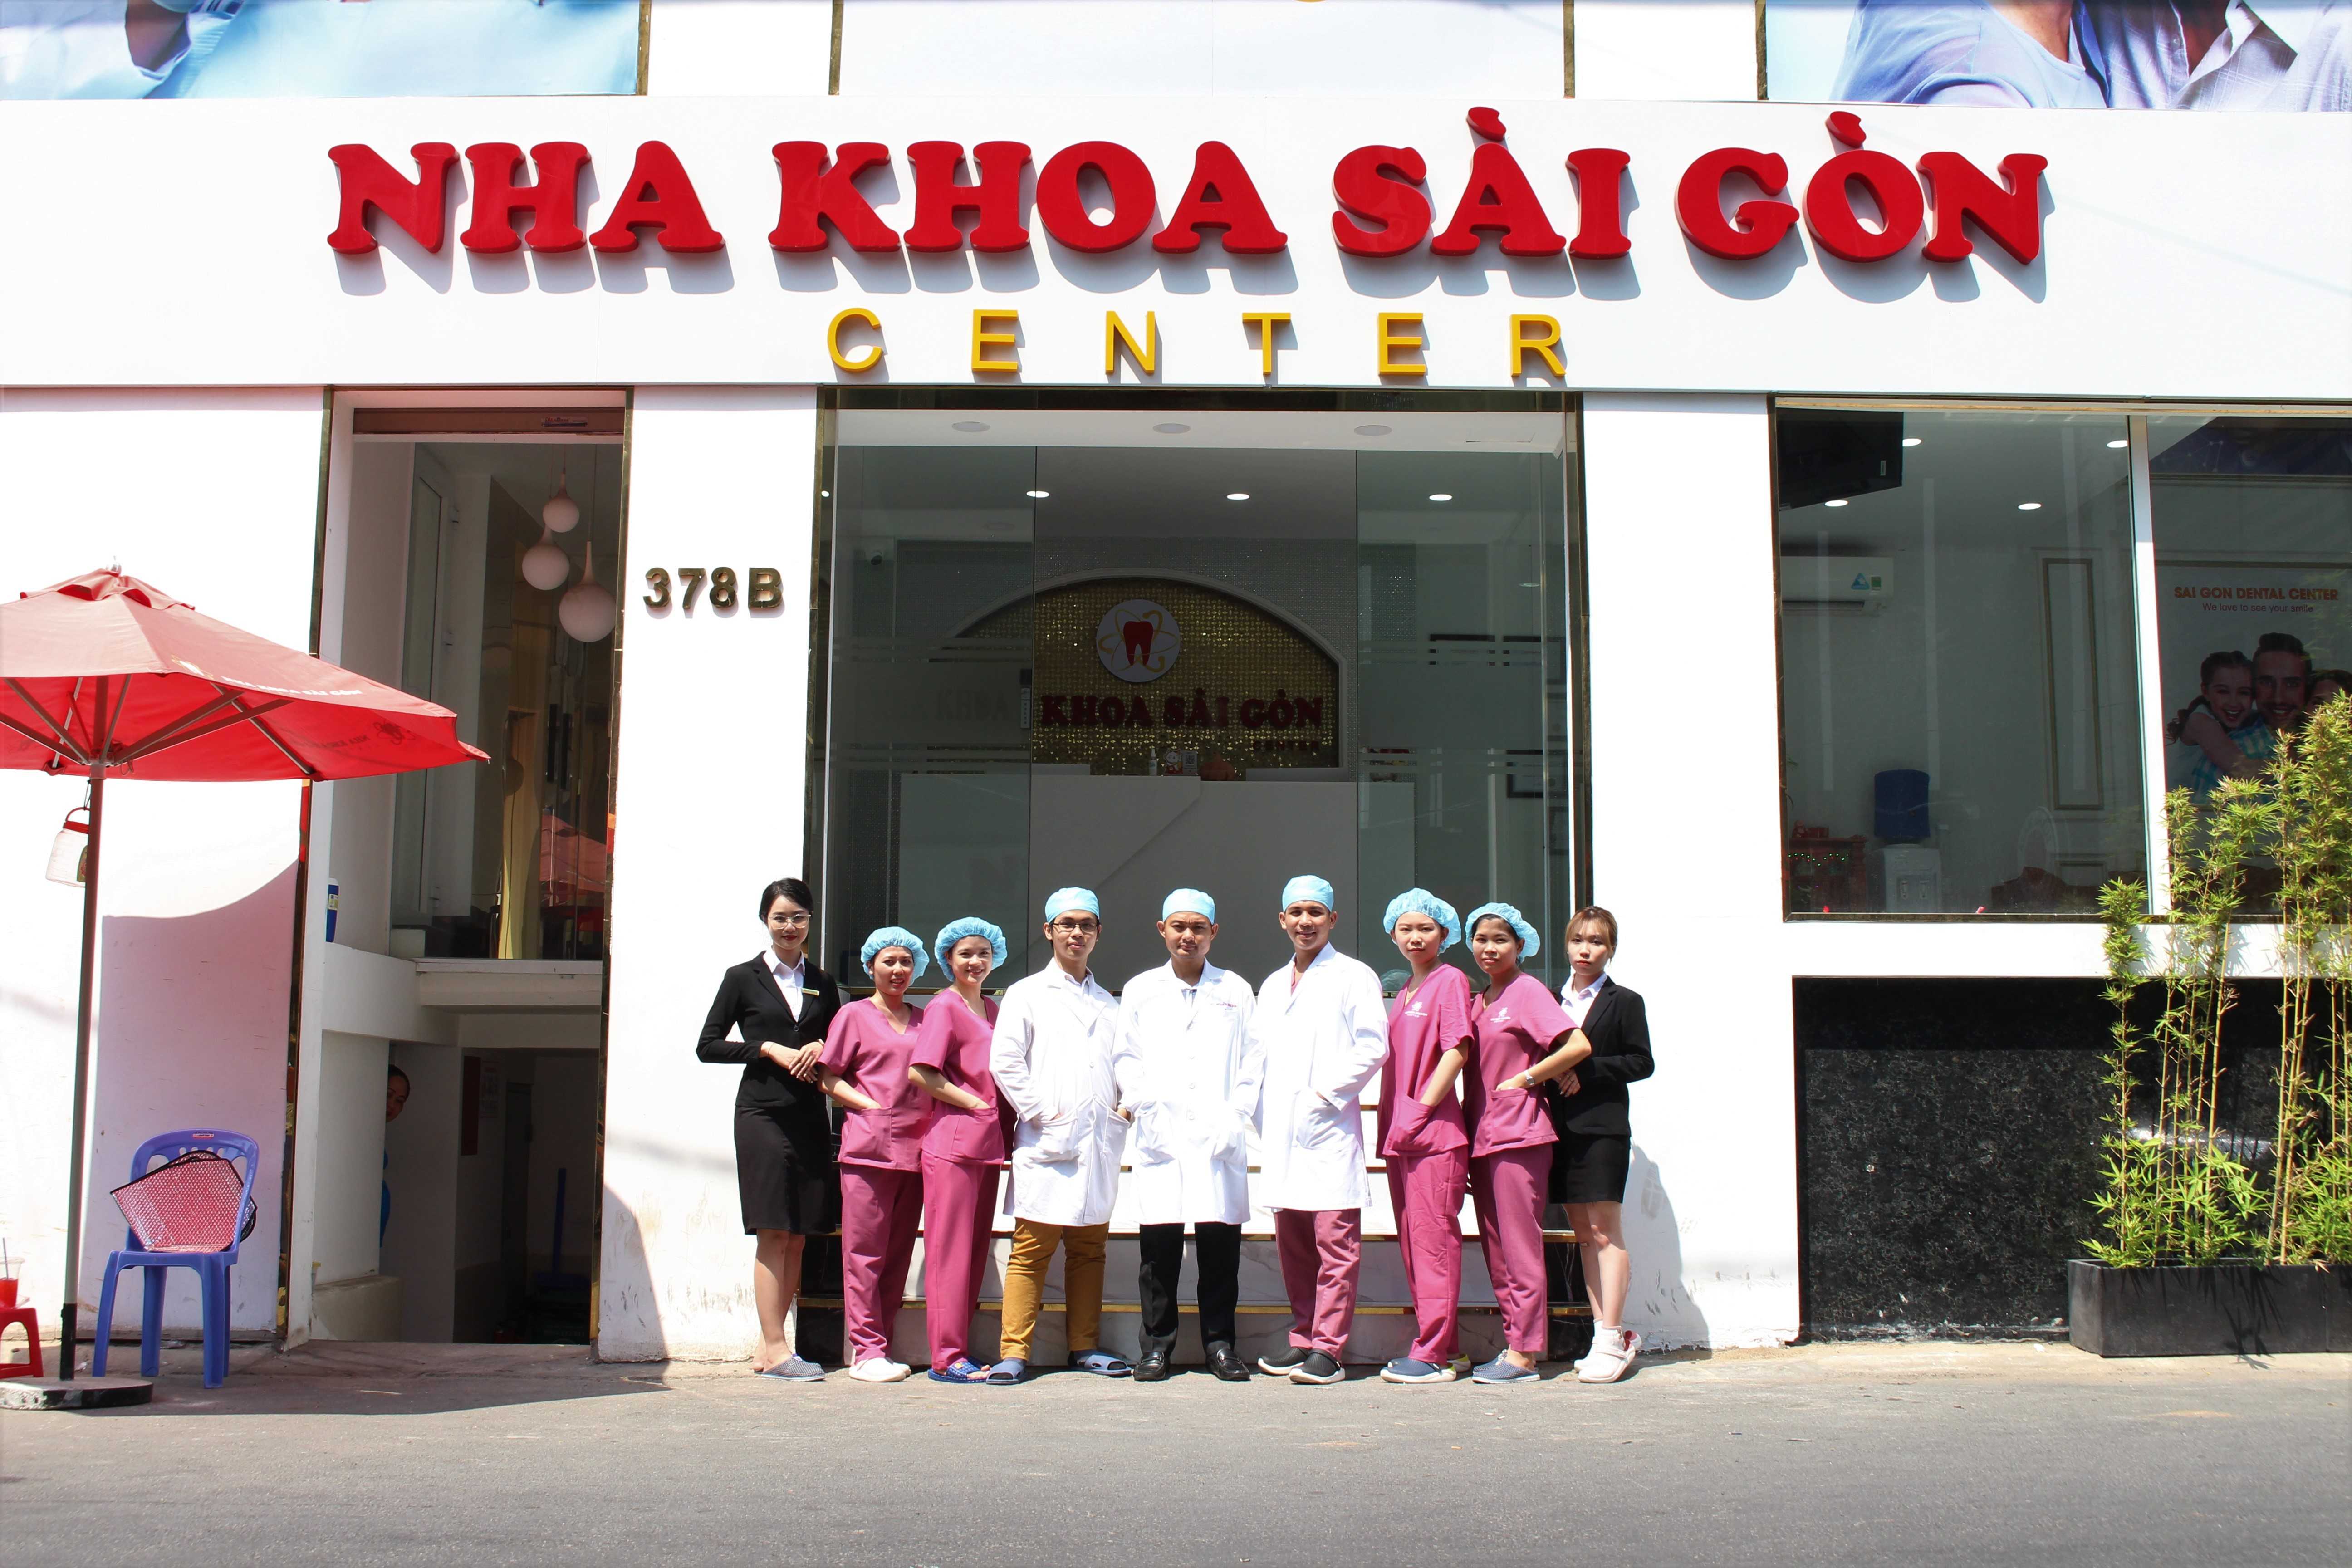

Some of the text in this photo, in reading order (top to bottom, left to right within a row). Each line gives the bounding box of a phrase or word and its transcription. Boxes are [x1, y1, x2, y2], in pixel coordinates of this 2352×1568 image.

[328, 107, 2048, 265] NHA KHOA SÀI GÒN
[827, 307, 1566, 377] CENTER
[643, 566, 783, 610] 378B
[2174, 586, 2339, 601] SAI GON DENTAL CENTER
[2202, 603, 2217, 611] We
[2219, 603, 2238, 612] love
[2240, 604, 2248, 612] to
[2269, 605, 2288, 614] your
[2290, 604, 2313, 613] smile
[1041, 695, 1155, 727] KHOA
